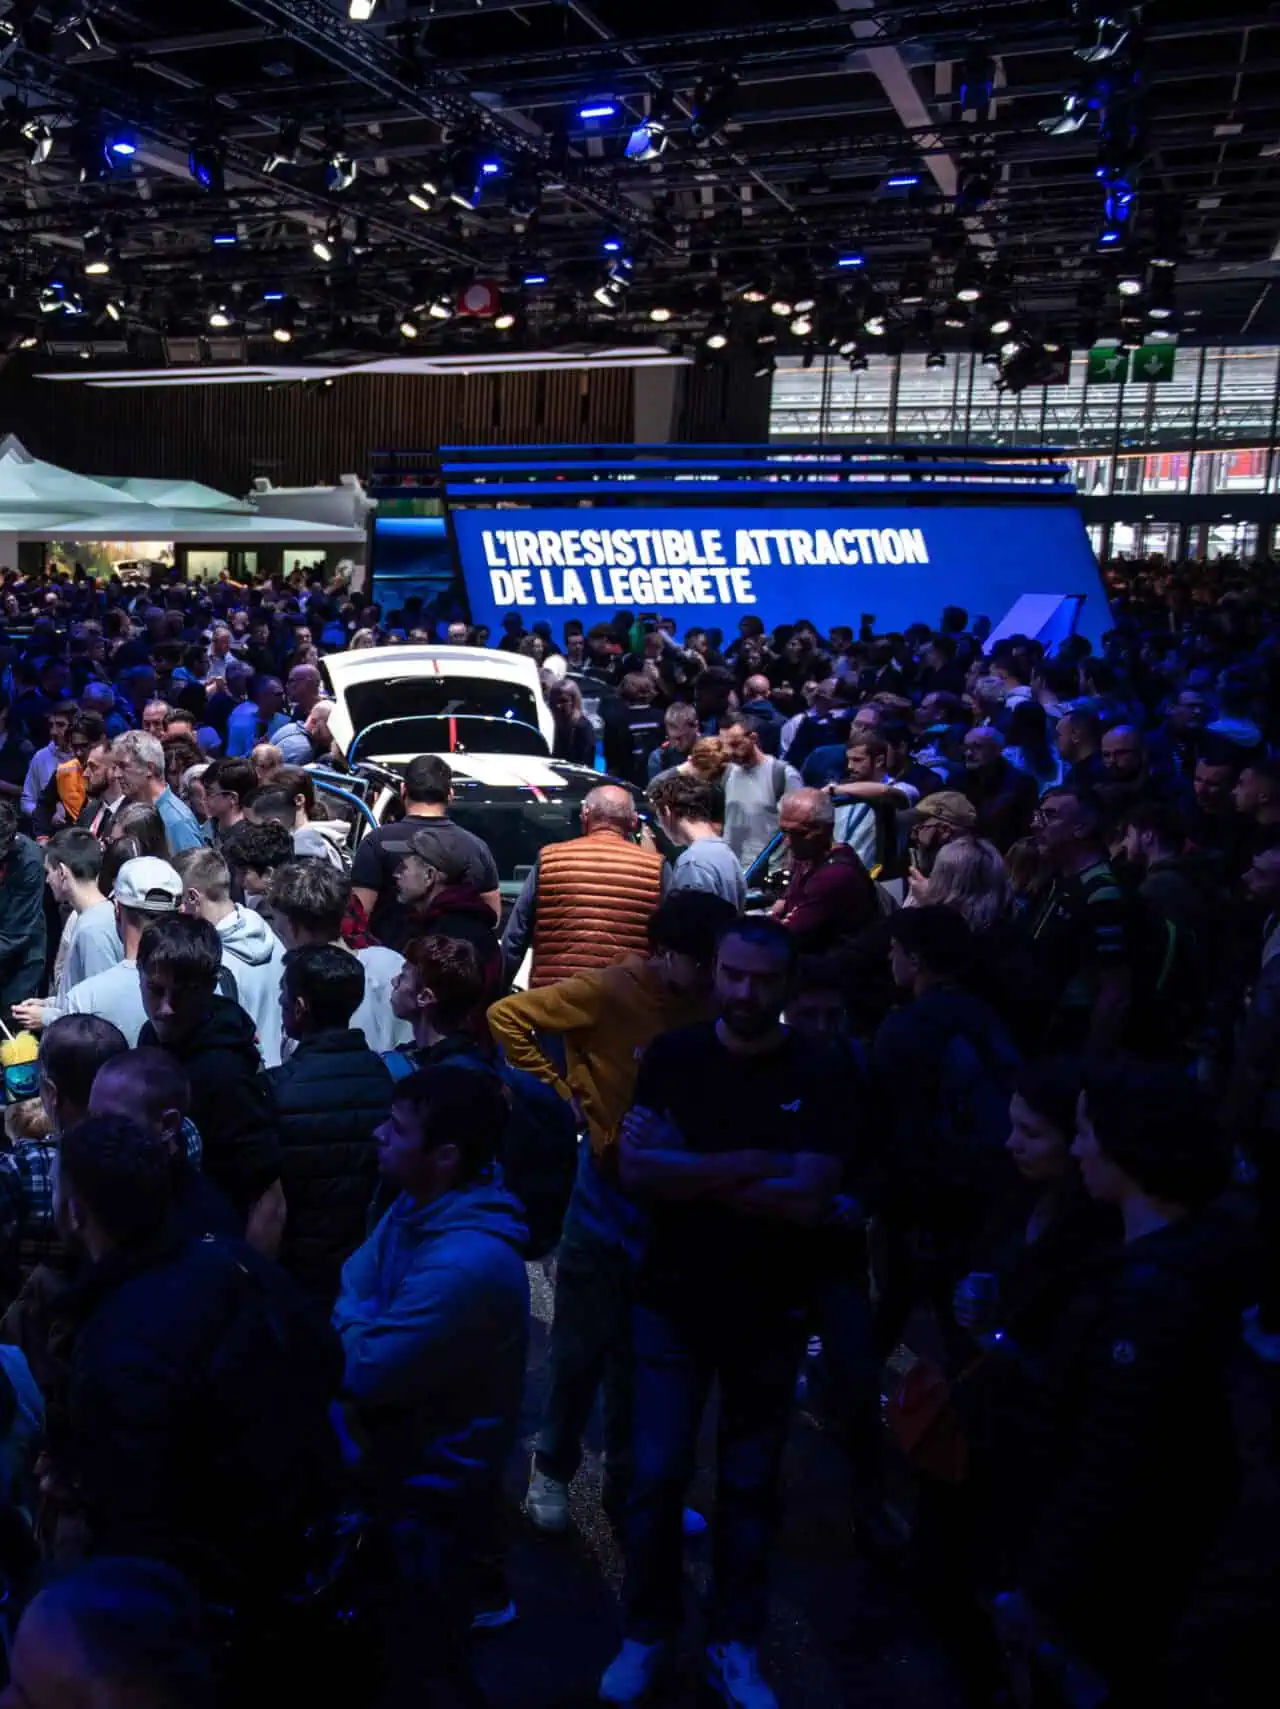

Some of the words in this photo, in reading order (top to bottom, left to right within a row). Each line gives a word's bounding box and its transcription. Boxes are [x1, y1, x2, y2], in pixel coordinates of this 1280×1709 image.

[482, 529, 727, 566] L'IRRESISTIBLE
[736, 528, 929, 565] ATTRACTION
[489, 568, 536, 605] DE
[539, 568, 588, 605] LA
[590, 567, 756, 605] LEGERETE
